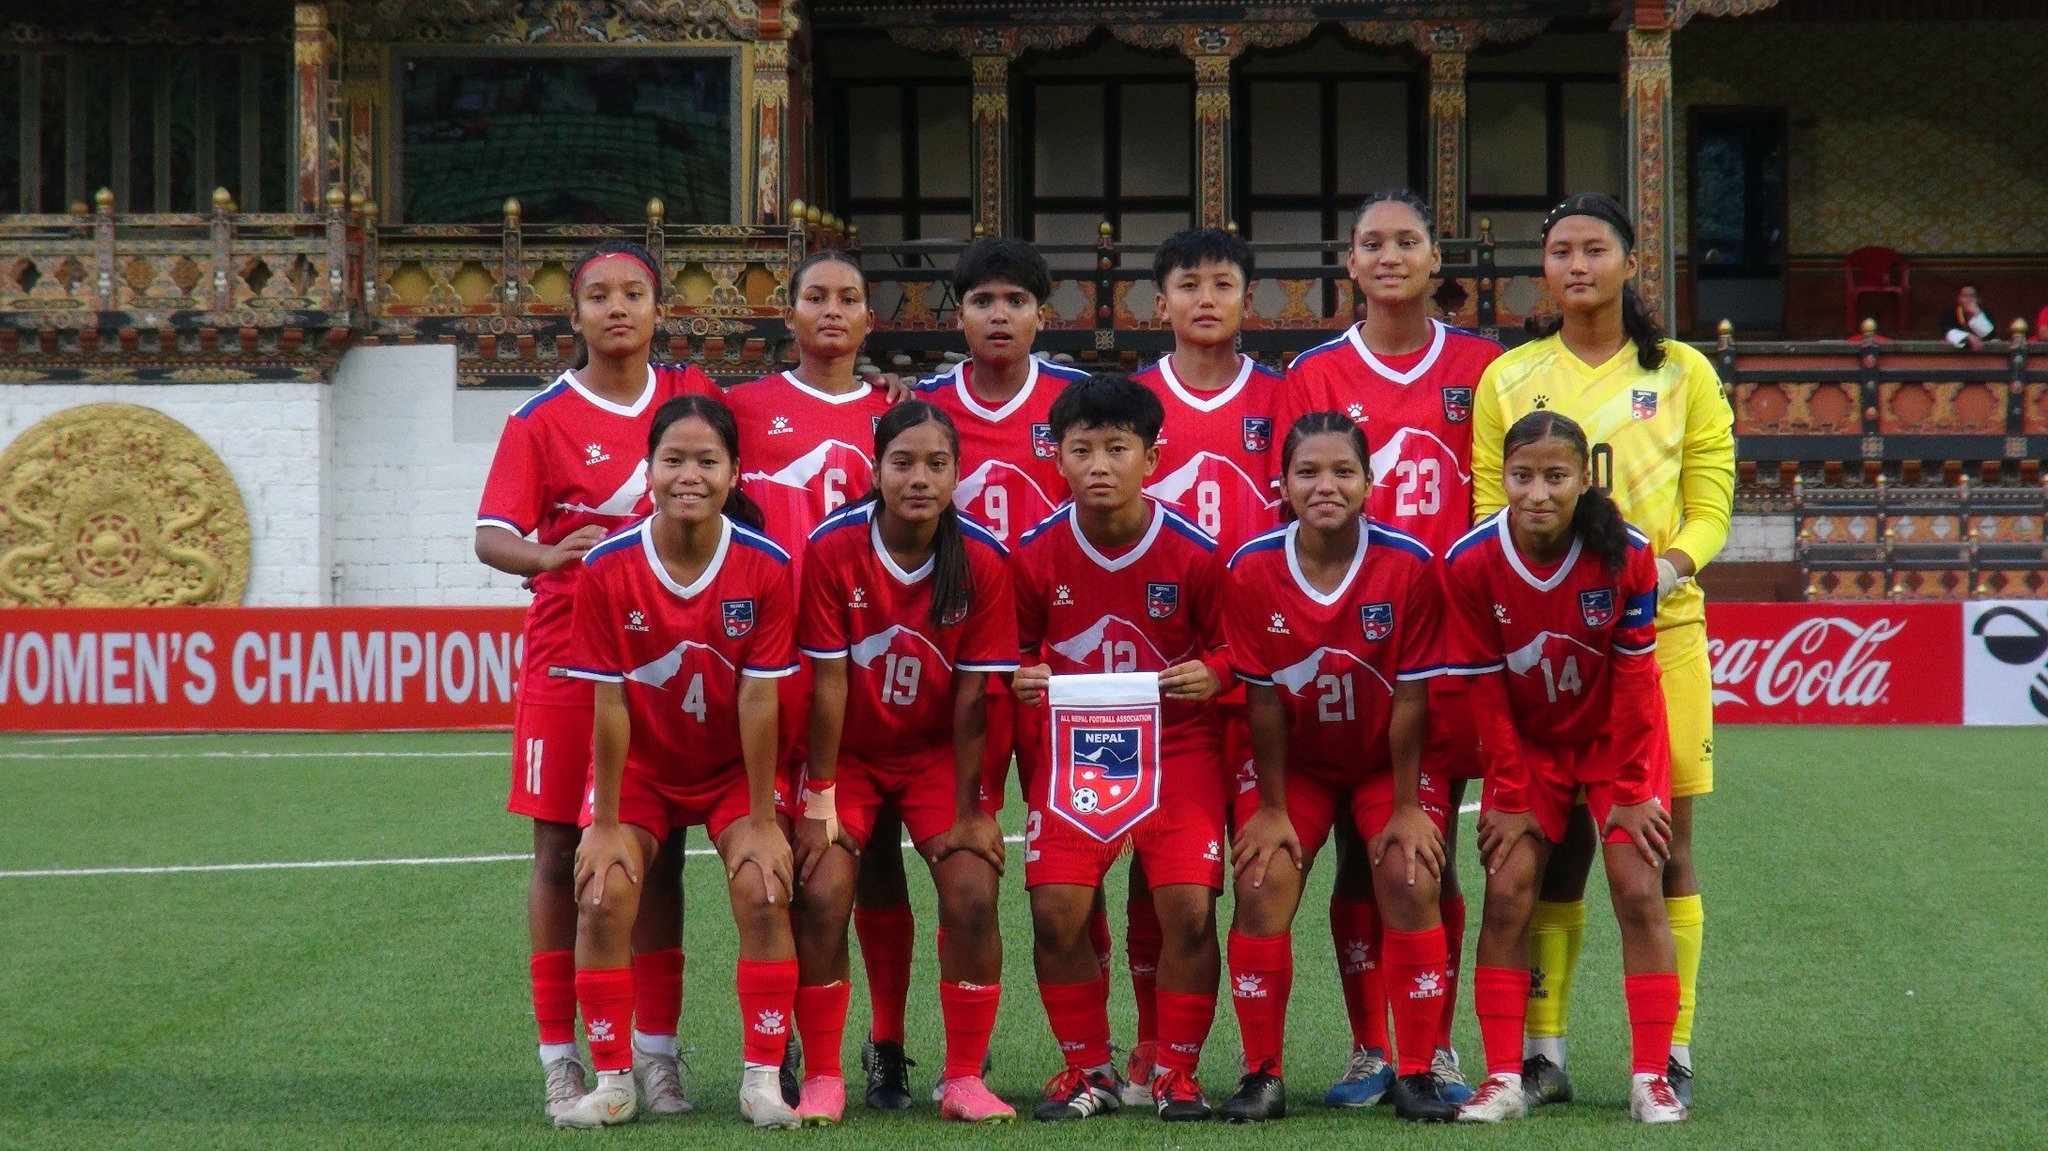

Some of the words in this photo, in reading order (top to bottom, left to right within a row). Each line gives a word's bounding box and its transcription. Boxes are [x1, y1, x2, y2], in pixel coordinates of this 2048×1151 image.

[768, 428, 794, 436] KELME
[585, 453, 611, 467] KELME
[824, 468, 847, 526] 6
[1396, 459, 1440, 516] 23
[985, 485, 1009, 541] 9
[1197, 481, 1221, 537] 8
[624, 624, 650, 632] KELME
[232, 631, 523, 704] CHAMPION
[1102, 641, 1137, 673] 12
[681, 673, 706, 723] 4
[881, 653, 922, 705] 19
[1317, 673, 1355, 722] 21
[1541, 655, 1582, 703] 14
[1060, 714, 1070, 722] ALL
[1089, 714, 1115, 723] FOOTBALL
[1117, 714, 1152, 723] ASSOCIATION
[1085, 733, 1125, 743] NEPAL
[526, 738, 544, 795] 11
[1233, 989, 1267, 998] KELME
[1410, 988, 1443, 998] KELME
[588, 1033, 615, 1042] KELME
[755, 1024, 786, 1035] KELME
